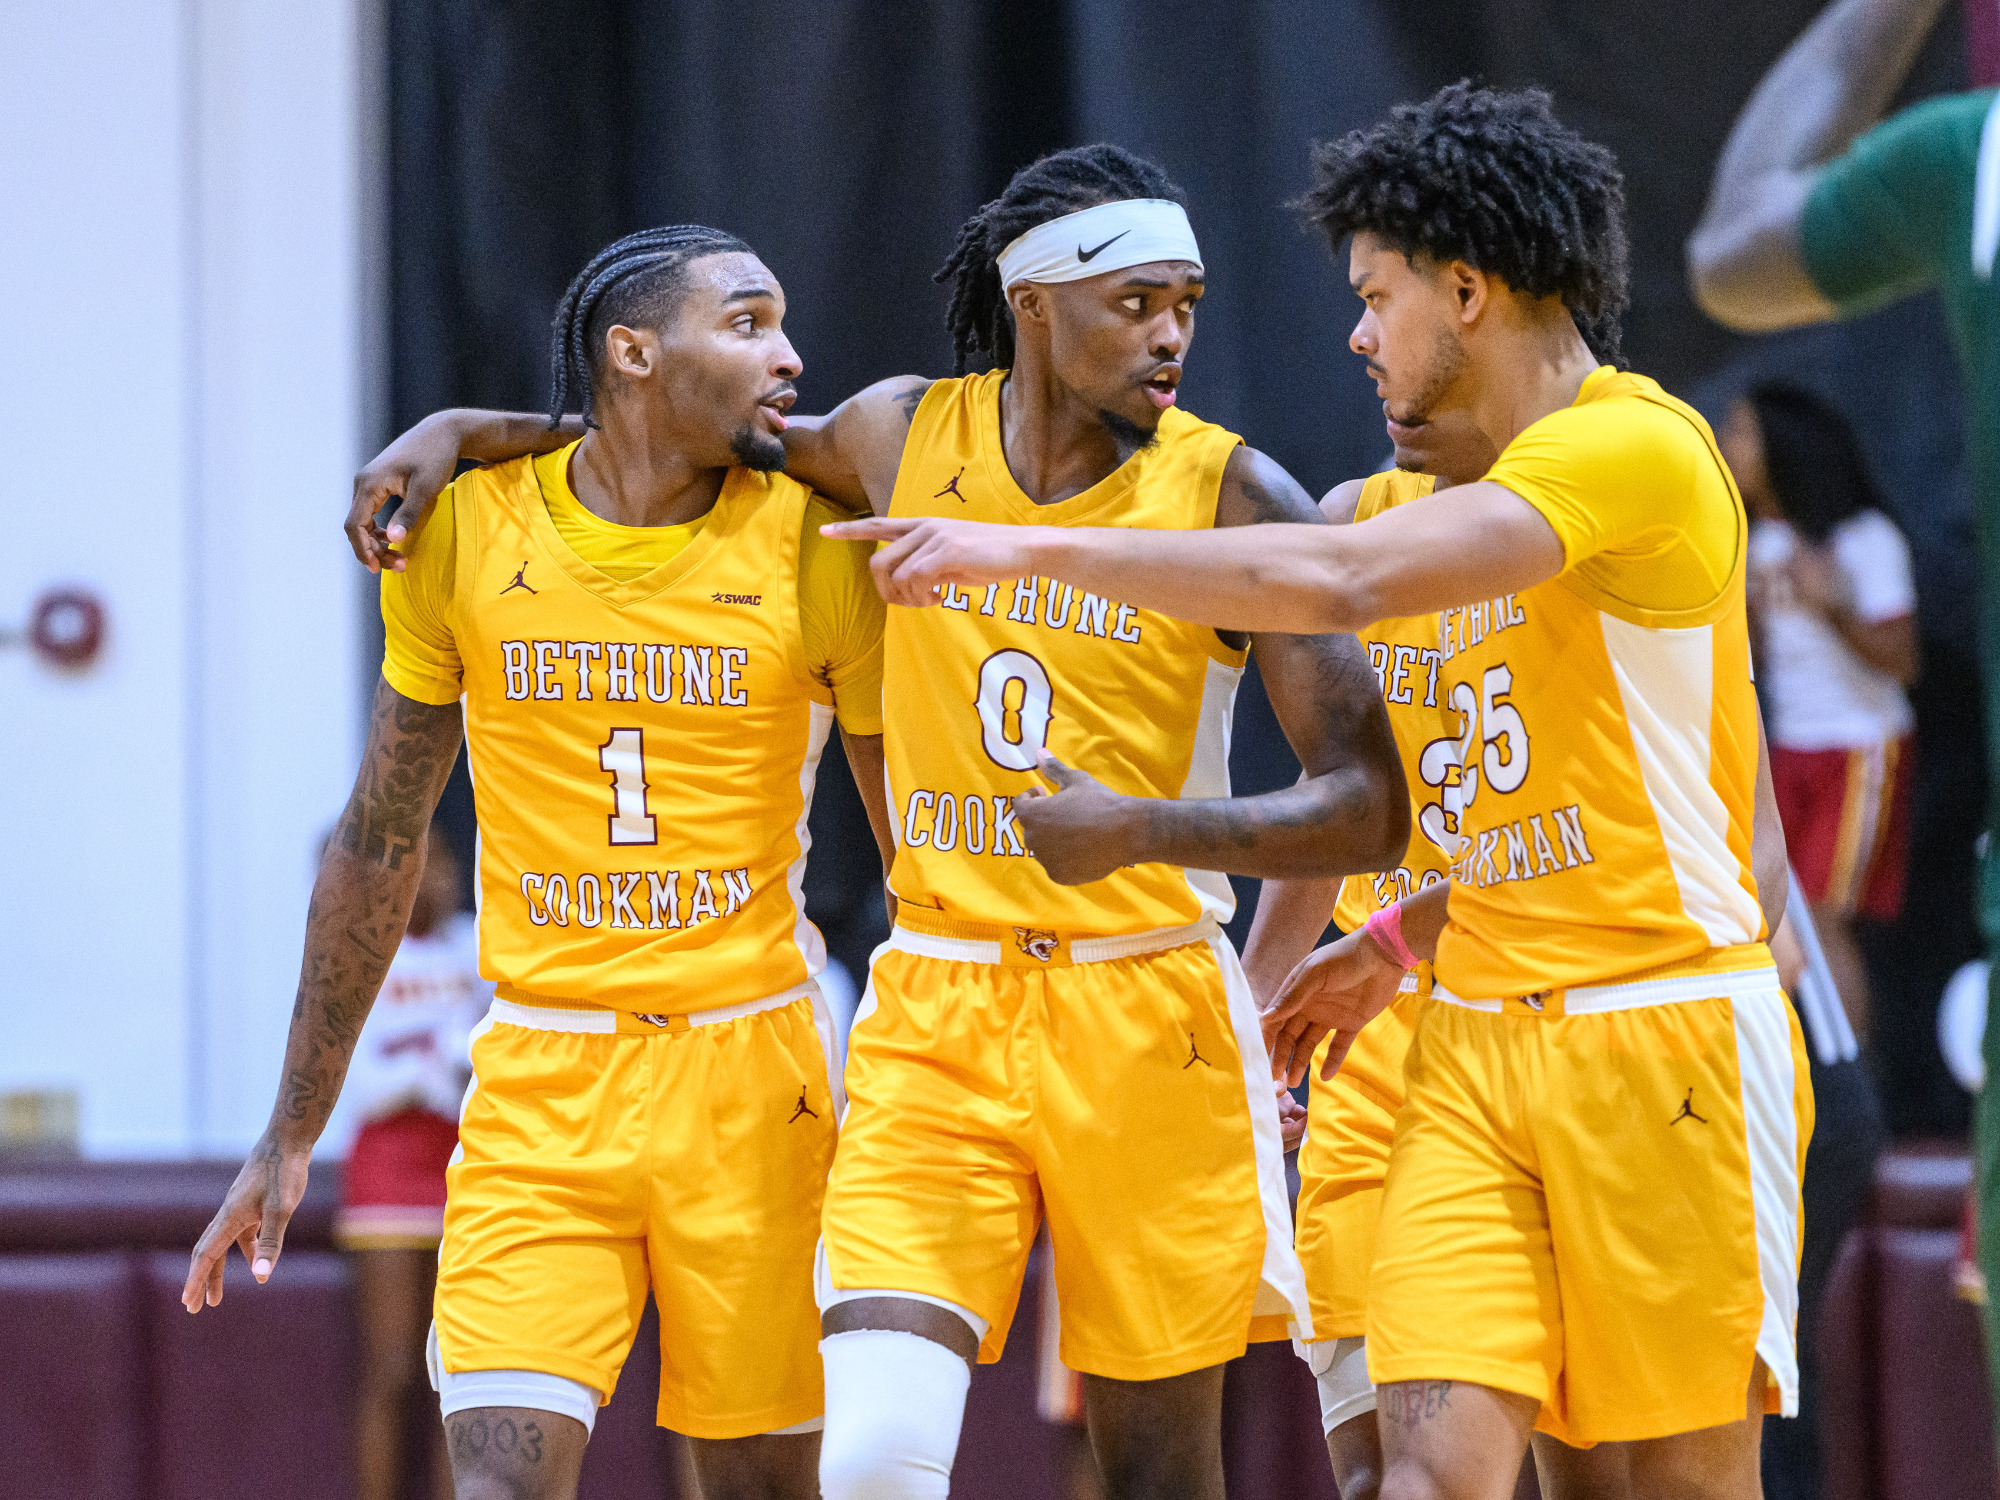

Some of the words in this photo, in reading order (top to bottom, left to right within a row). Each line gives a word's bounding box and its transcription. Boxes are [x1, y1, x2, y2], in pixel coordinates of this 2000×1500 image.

[724, 594, 762, 606] SWAC
[501, 640, 748, 707] BETHUNE
[973, 648, 1054, 772] 0
[1453, 661, 1530, 809] 25
[598, 727, 658, 846] 1
[520, 868, 753, 930] COOKMAN
